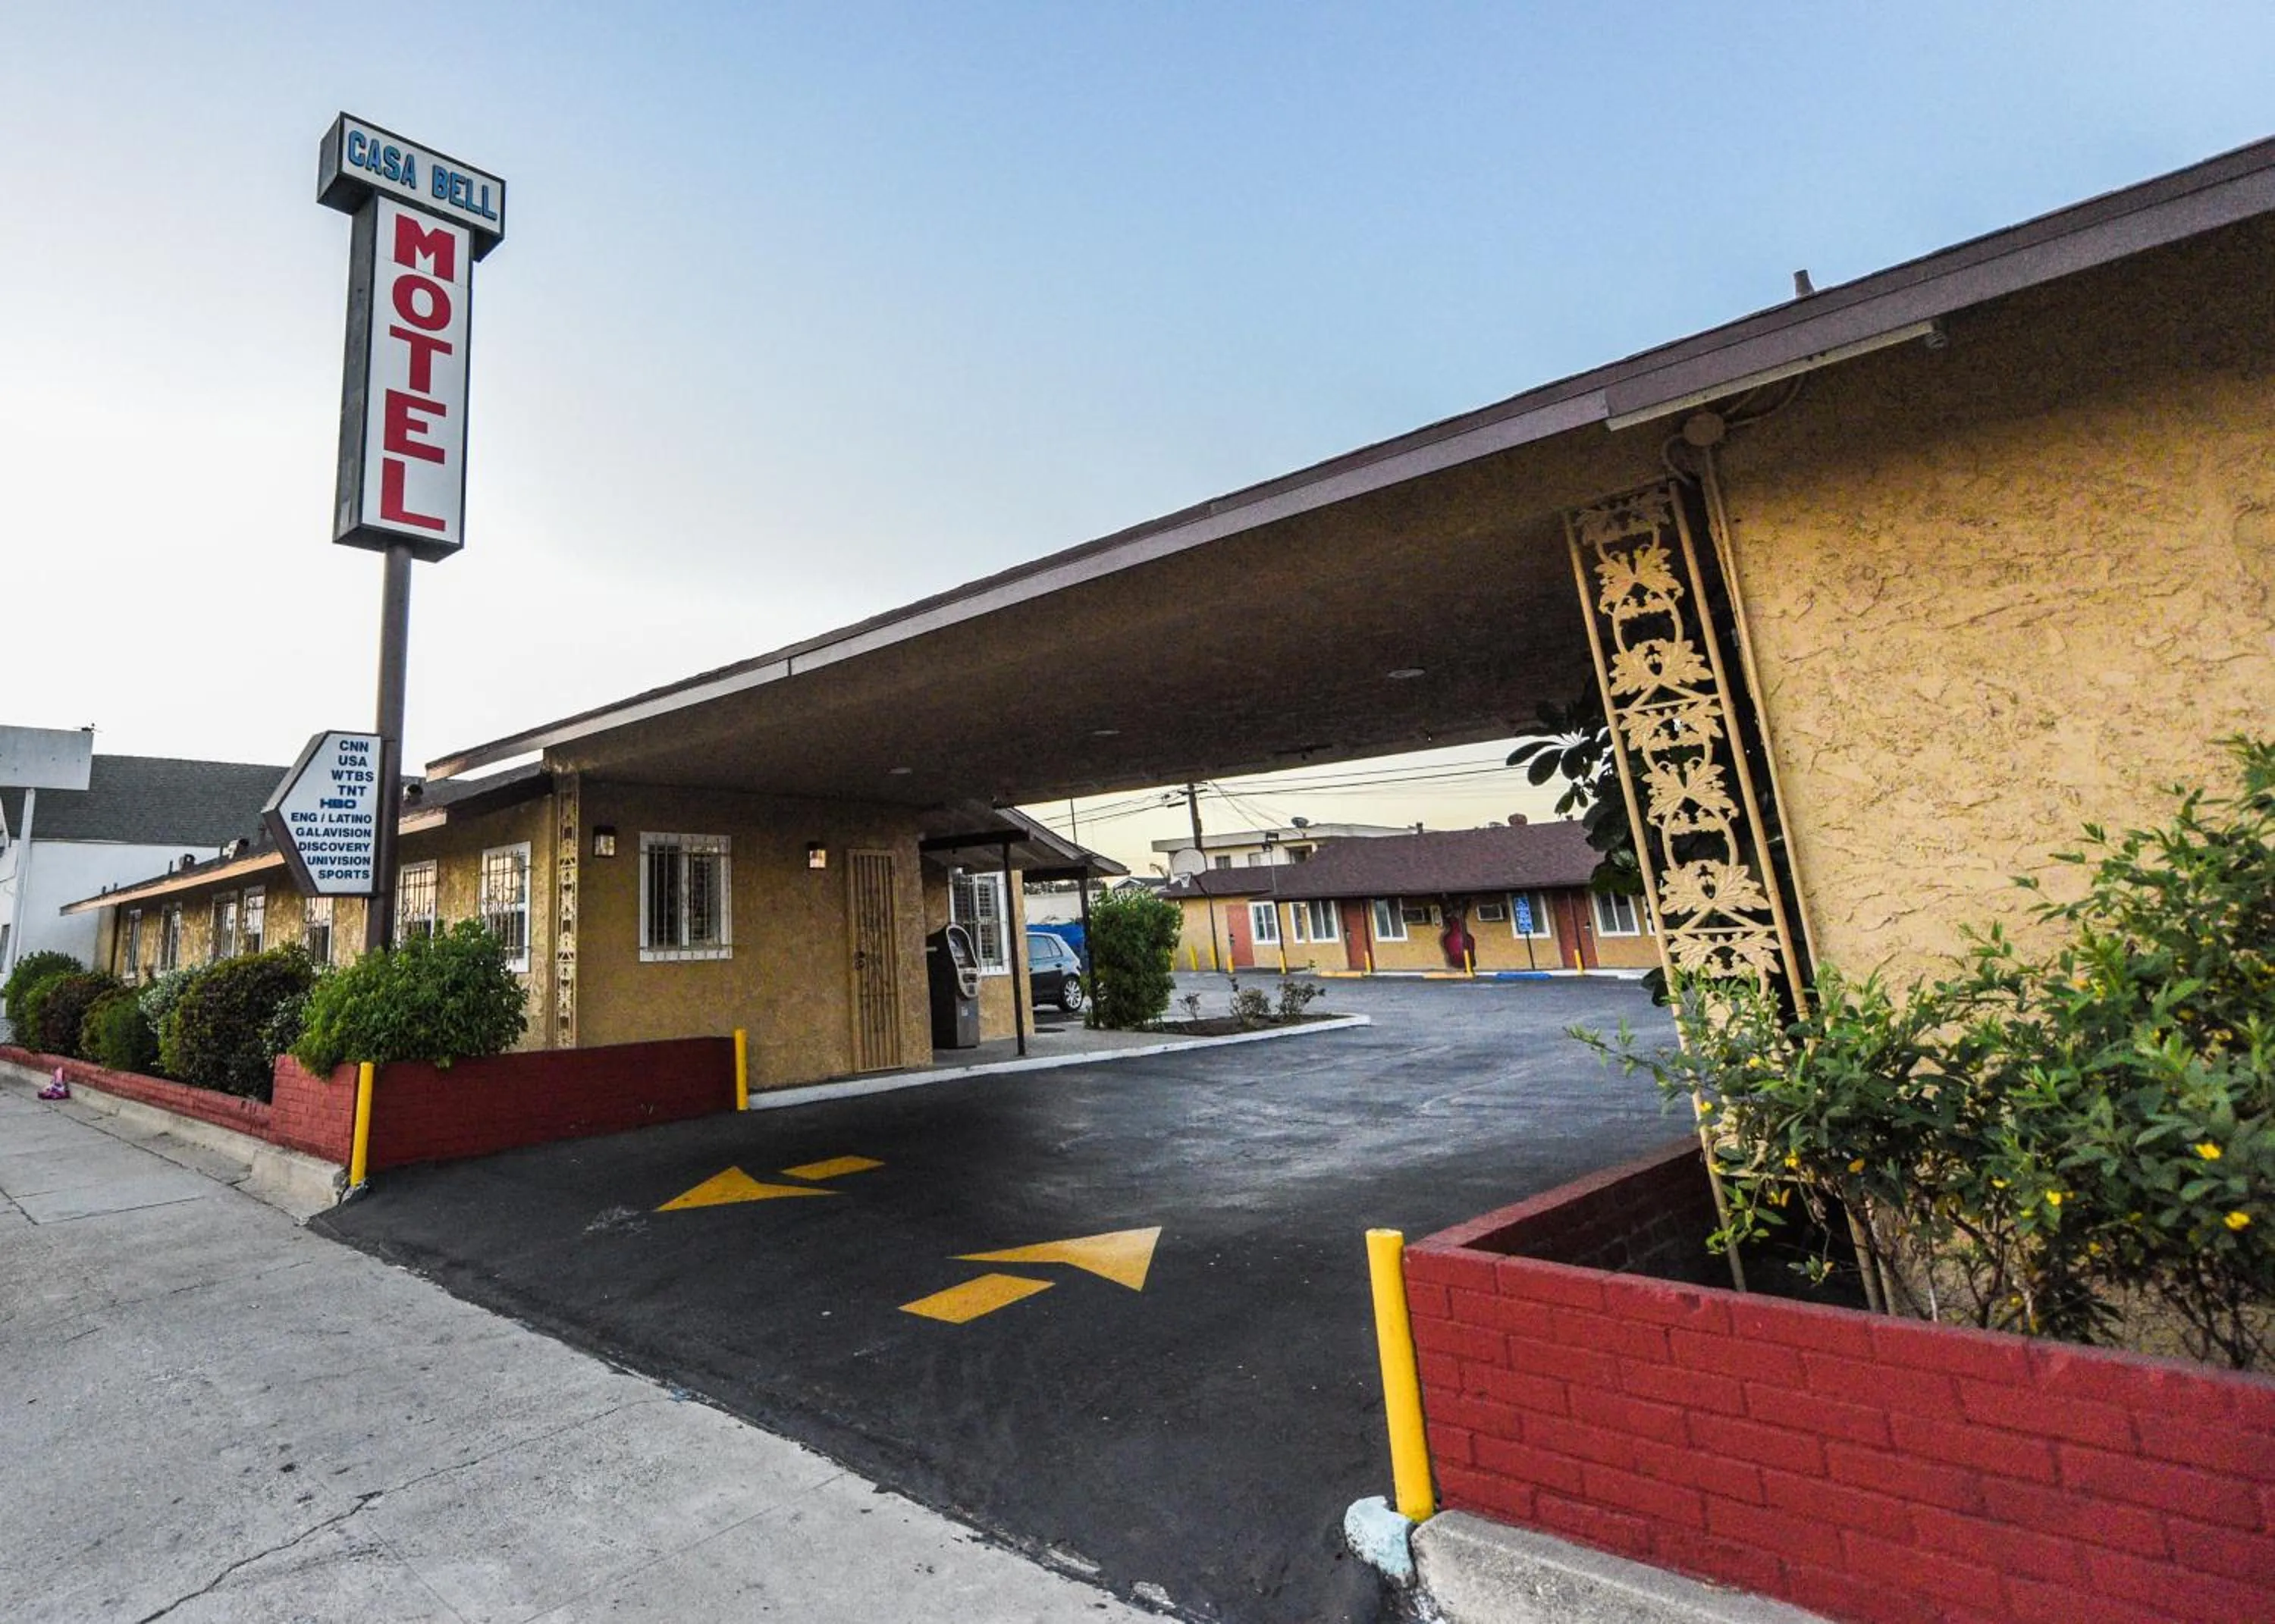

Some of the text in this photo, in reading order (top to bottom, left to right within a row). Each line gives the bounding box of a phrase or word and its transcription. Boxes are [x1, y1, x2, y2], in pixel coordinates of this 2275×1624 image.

[348, 130, 497, 221] CASA BELL
[380, 213, 456, 531] MOTEL
[339, 740, 369, 752] CNN
[337, 755, 368, 767] USA
[331, 770, 374, 782] WTBS
[337, 785, 367, 797] TNT
[319, 798, 357, 810] HBO
[290, 812, 318, 823] ENG
[328, 814, 372, 824] LATINO
[295, 827, 372, 838] GALAVISION
[298, 842, 371, 852] DISCOVERY
[307, 856, 371, 866] UNIVISION
[318, 870, 370, 879] SPORTS
